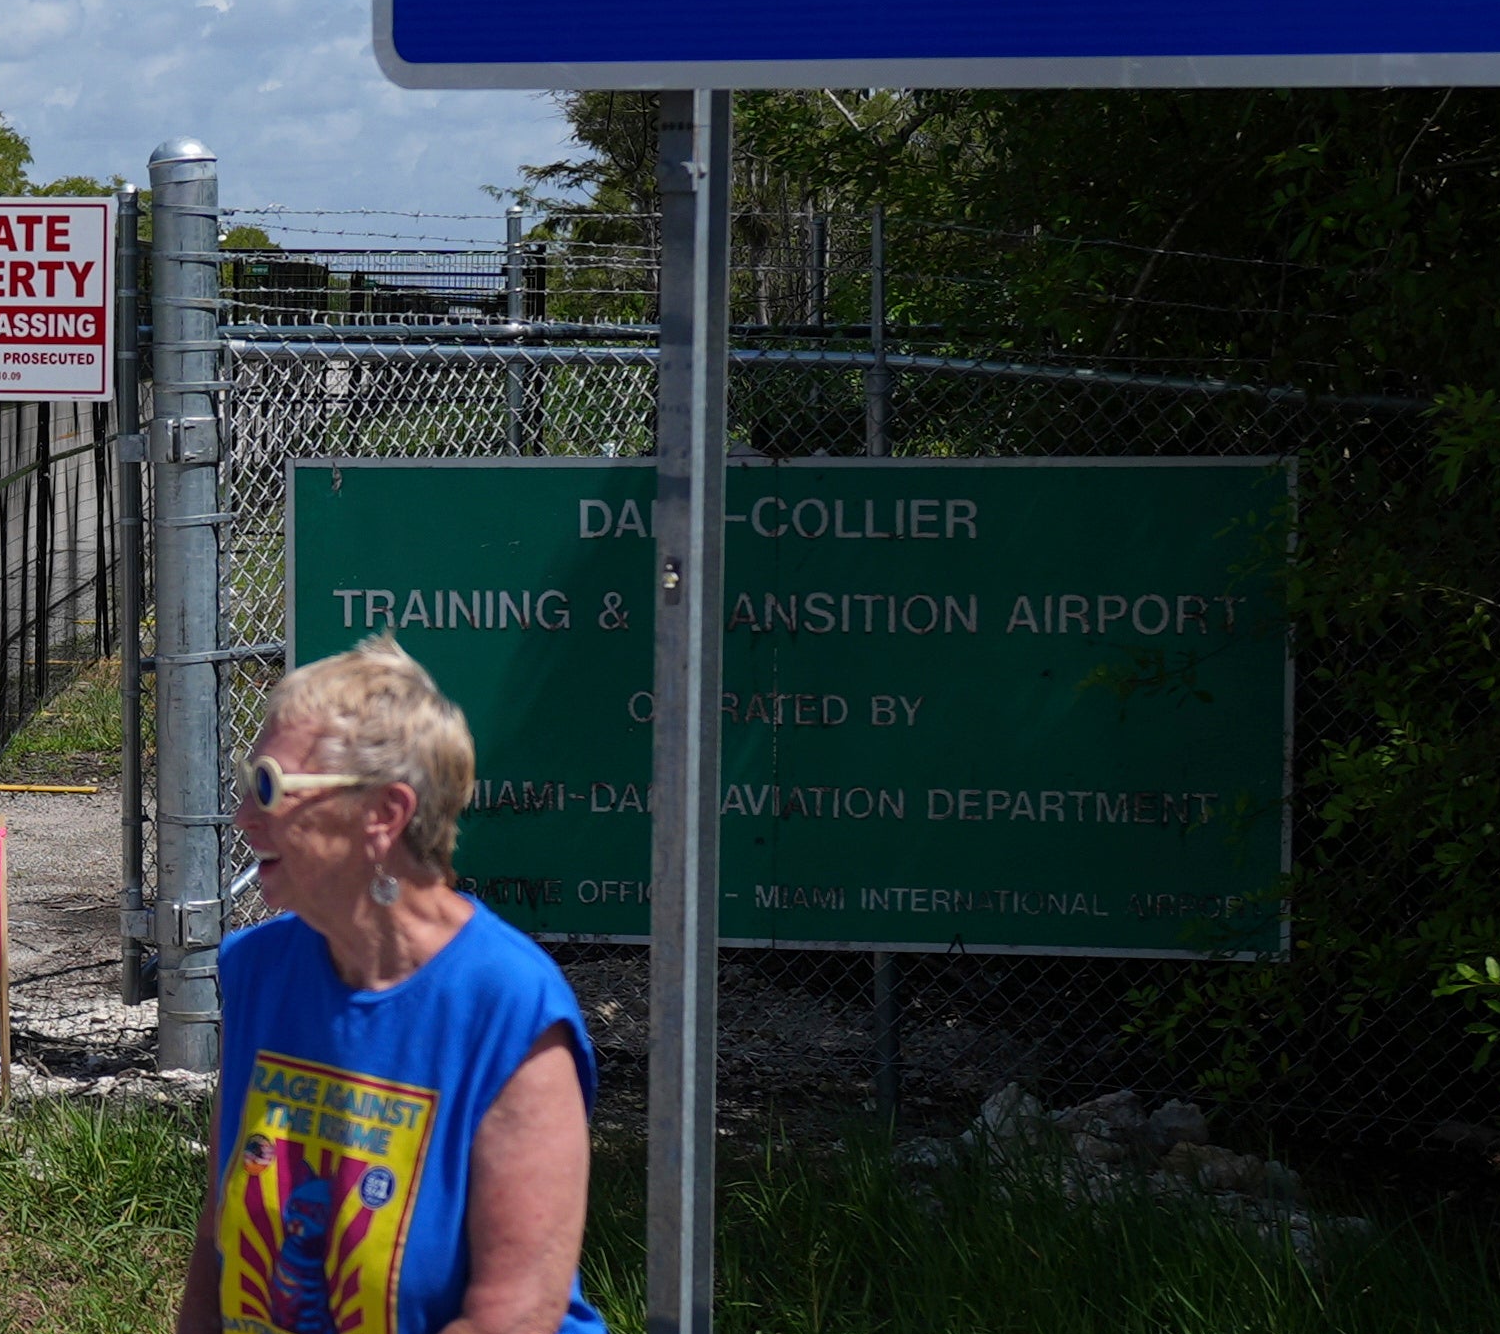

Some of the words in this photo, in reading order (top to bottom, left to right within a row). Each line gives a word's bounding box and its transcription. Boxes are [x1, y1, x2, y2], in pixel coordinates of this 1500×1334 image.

[2, 351, 95, 366] PROSECUTED
[578, 496, 980, 540] DA-COLLIER
[332, 589, 571, 631] TRAINING
[597, 591, 630, 631] &
[727, 591, 979, 636] ANSITION
[1005, 592, 1248, 636] AIRPORT
[627, 690, 848, 727] ORATED
[870, 694, 925, 727] BY
[719, 783, 906, 820] AVIATION
[926, 787, 1219, 824] DEPARTMENT
[754, 883, 846, 910] MIAMI
[860, 886, 1109, 917] INTERNATIONAL
[1126, 891, 1263, 921] AIRPOR
[251, 1064, 321, 1105] RAGE
